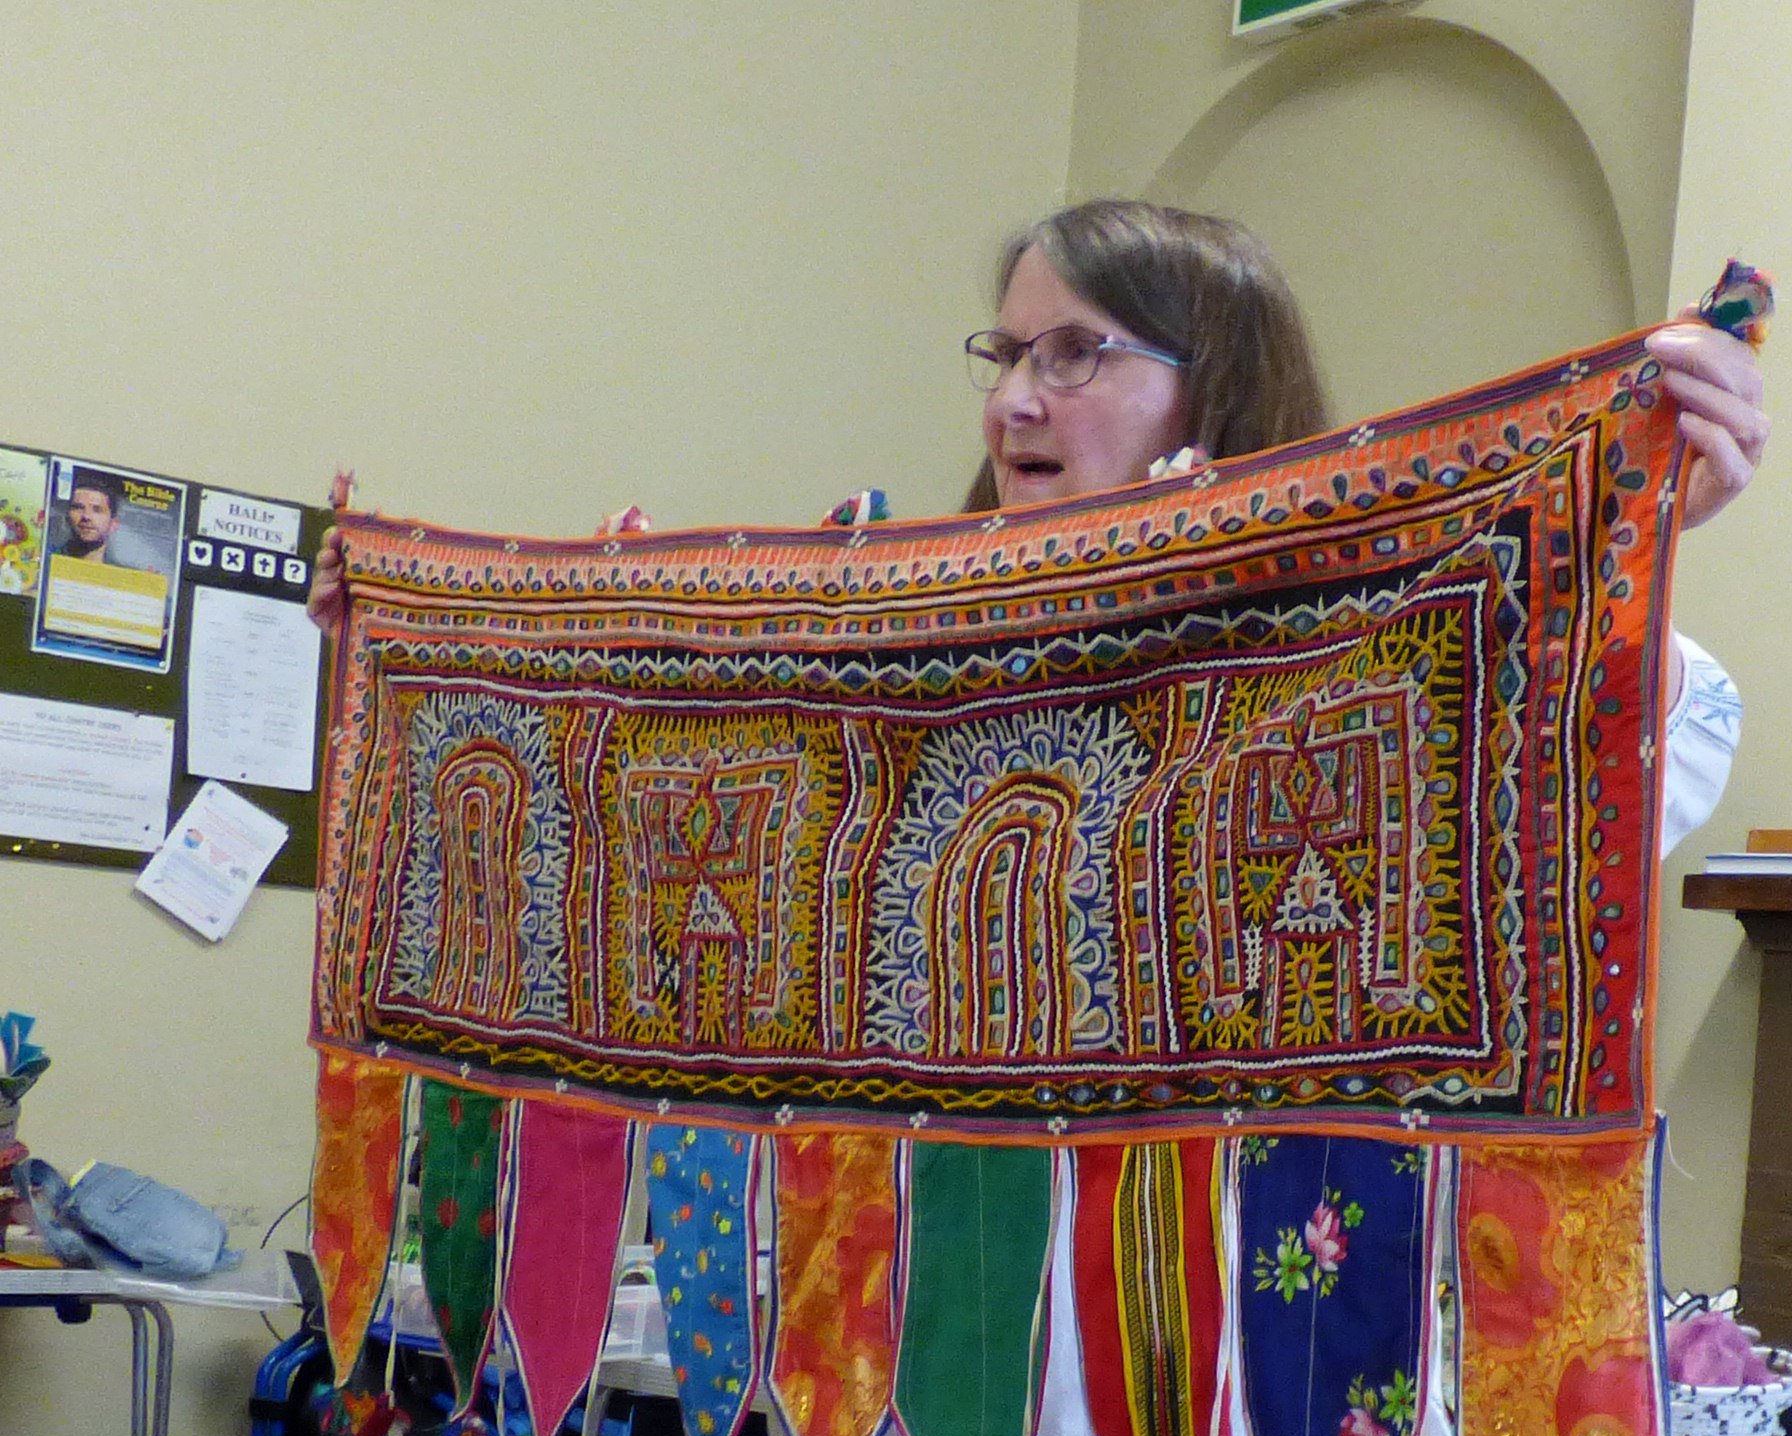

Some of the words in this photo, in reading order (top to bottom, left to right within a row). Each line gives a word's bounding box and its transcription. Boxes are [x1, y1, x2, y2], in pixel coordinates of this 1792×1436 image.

[123, 480, 145, 496] The
[146, 486, 175, 502] Bible
[129, 493, 168, 511] Course
[228, 503, 271, 523] HALL
[214, 518, 284, 544] NOTICES
